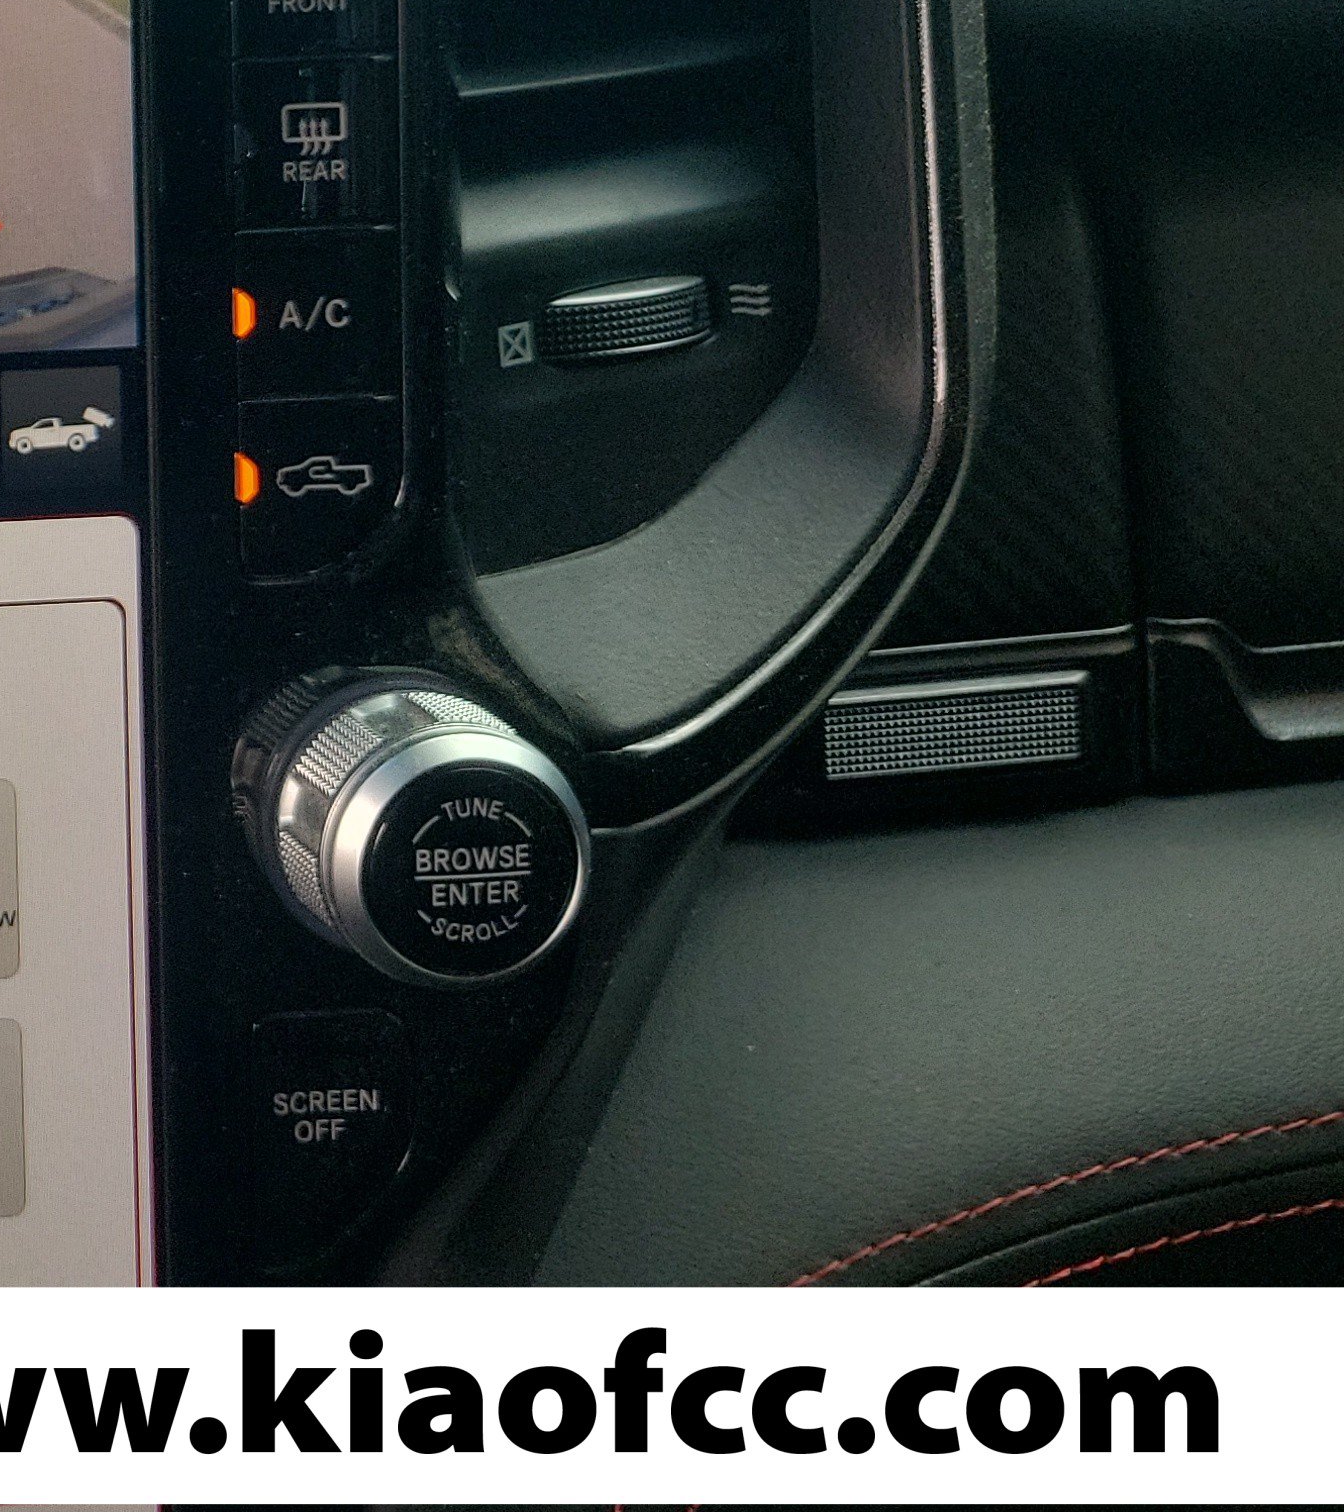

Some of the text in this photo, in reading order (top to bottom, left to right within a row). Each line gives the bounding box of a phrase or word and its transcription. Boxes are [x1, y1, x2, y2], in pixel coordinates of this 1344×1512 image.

[281, 159, 347, 184] REAR
[278, 296, 351, 333] A/C
[441, 797, 504, 823] TUNE
[415, 844, 531, 874] BROWSE
[431, 880, 521, 908] ENTER
[430, 914, 518, 944] SCROLL
[273, 1088, 379, 1116] SCREEN
[294, 1119, 345, 1144] OFF
